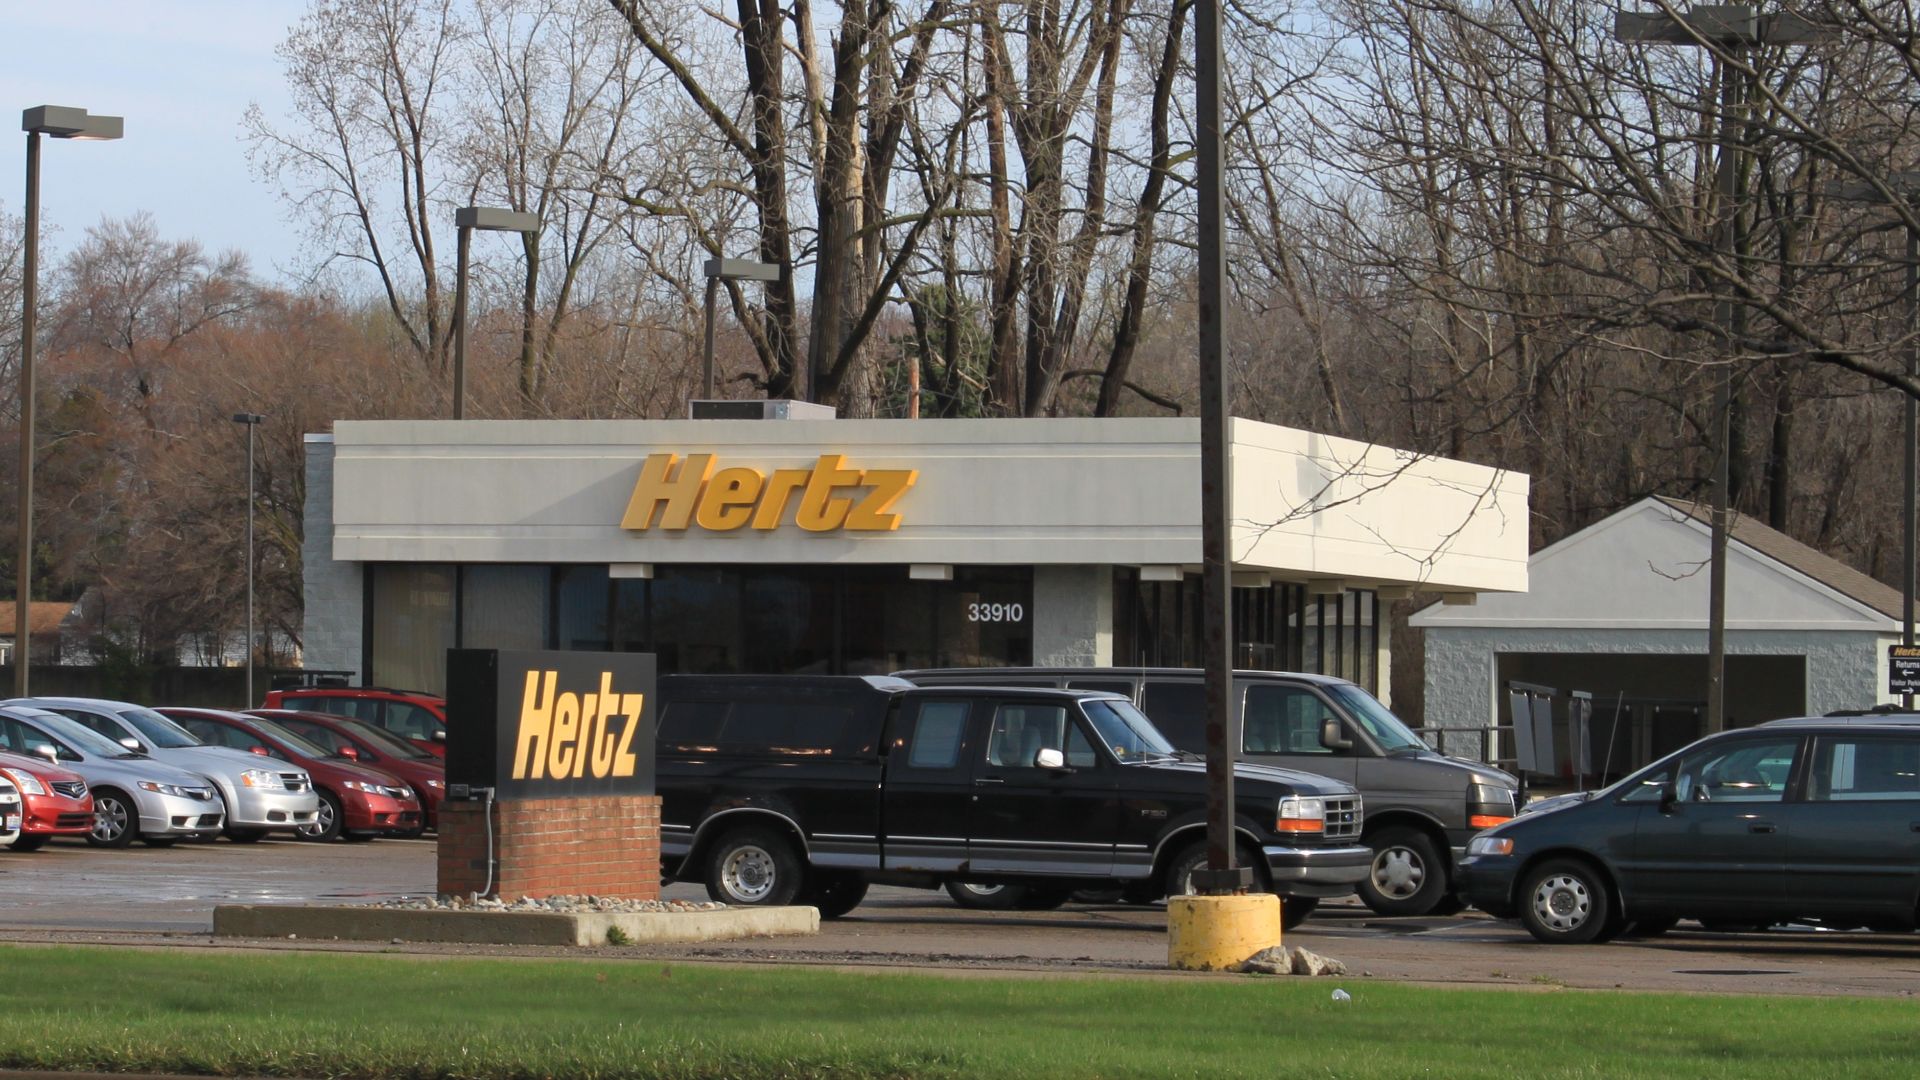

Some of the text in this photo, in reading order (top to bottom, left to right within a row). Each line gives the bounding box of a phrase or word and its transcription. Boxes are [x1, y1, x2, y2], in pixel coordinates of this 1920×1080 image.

[620, 453, 919, 531] Hertz
[968, 603, 1023, 622] 33910
[1895, 660, 1920, 668] Returns
[512, 670, 643, 780] Hertz
